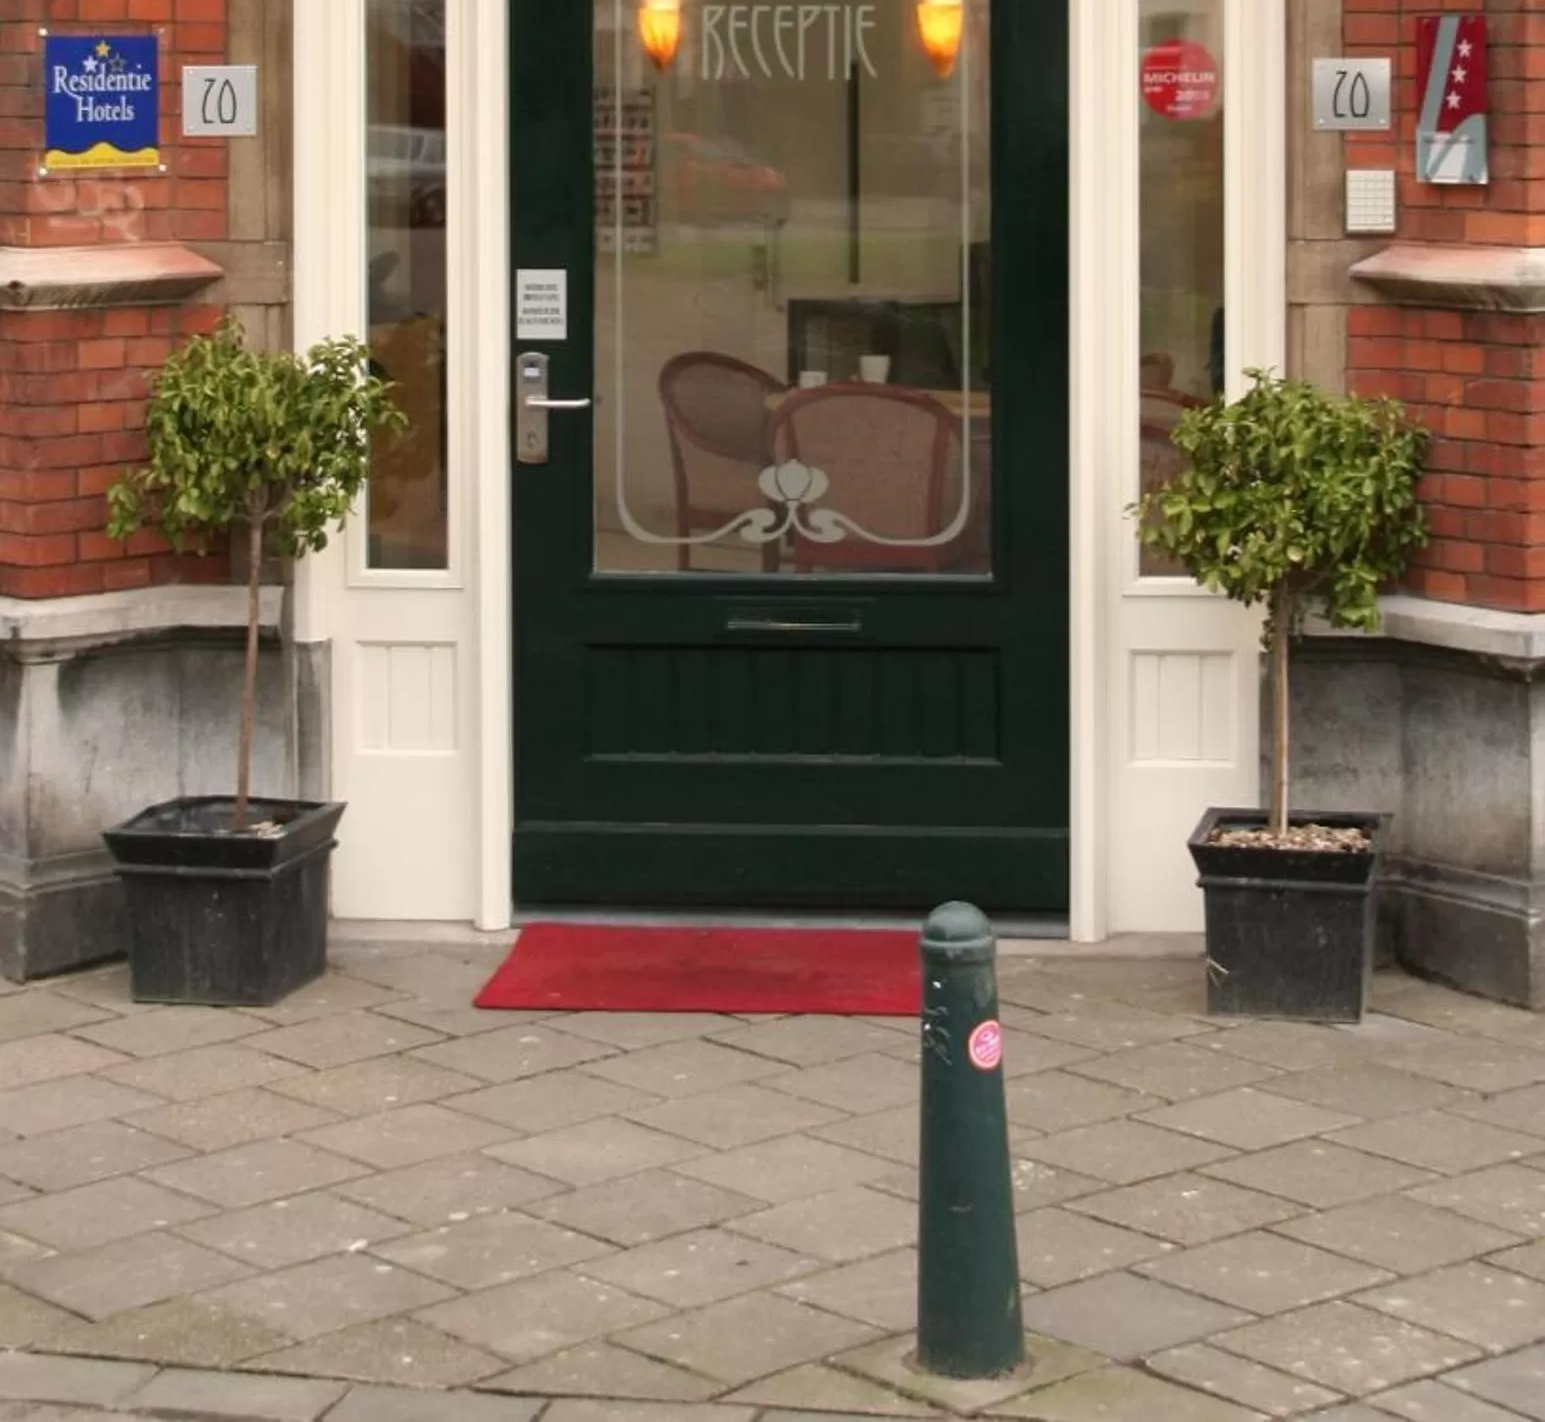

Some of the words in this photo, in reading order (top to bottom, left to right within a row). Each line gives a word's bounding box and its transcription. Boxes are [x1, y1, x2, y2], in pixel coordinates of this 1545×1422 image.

[703, 5, 877, 80] RECEPTIE
[53, 63, 152, 96] Residentie
[1143, 71, 1215, 83] MICHELIN
[1332, 70, 1370, 118] 20
[76, 95, 135, 122] Hotels
[202, 79, 236, 123] 20
